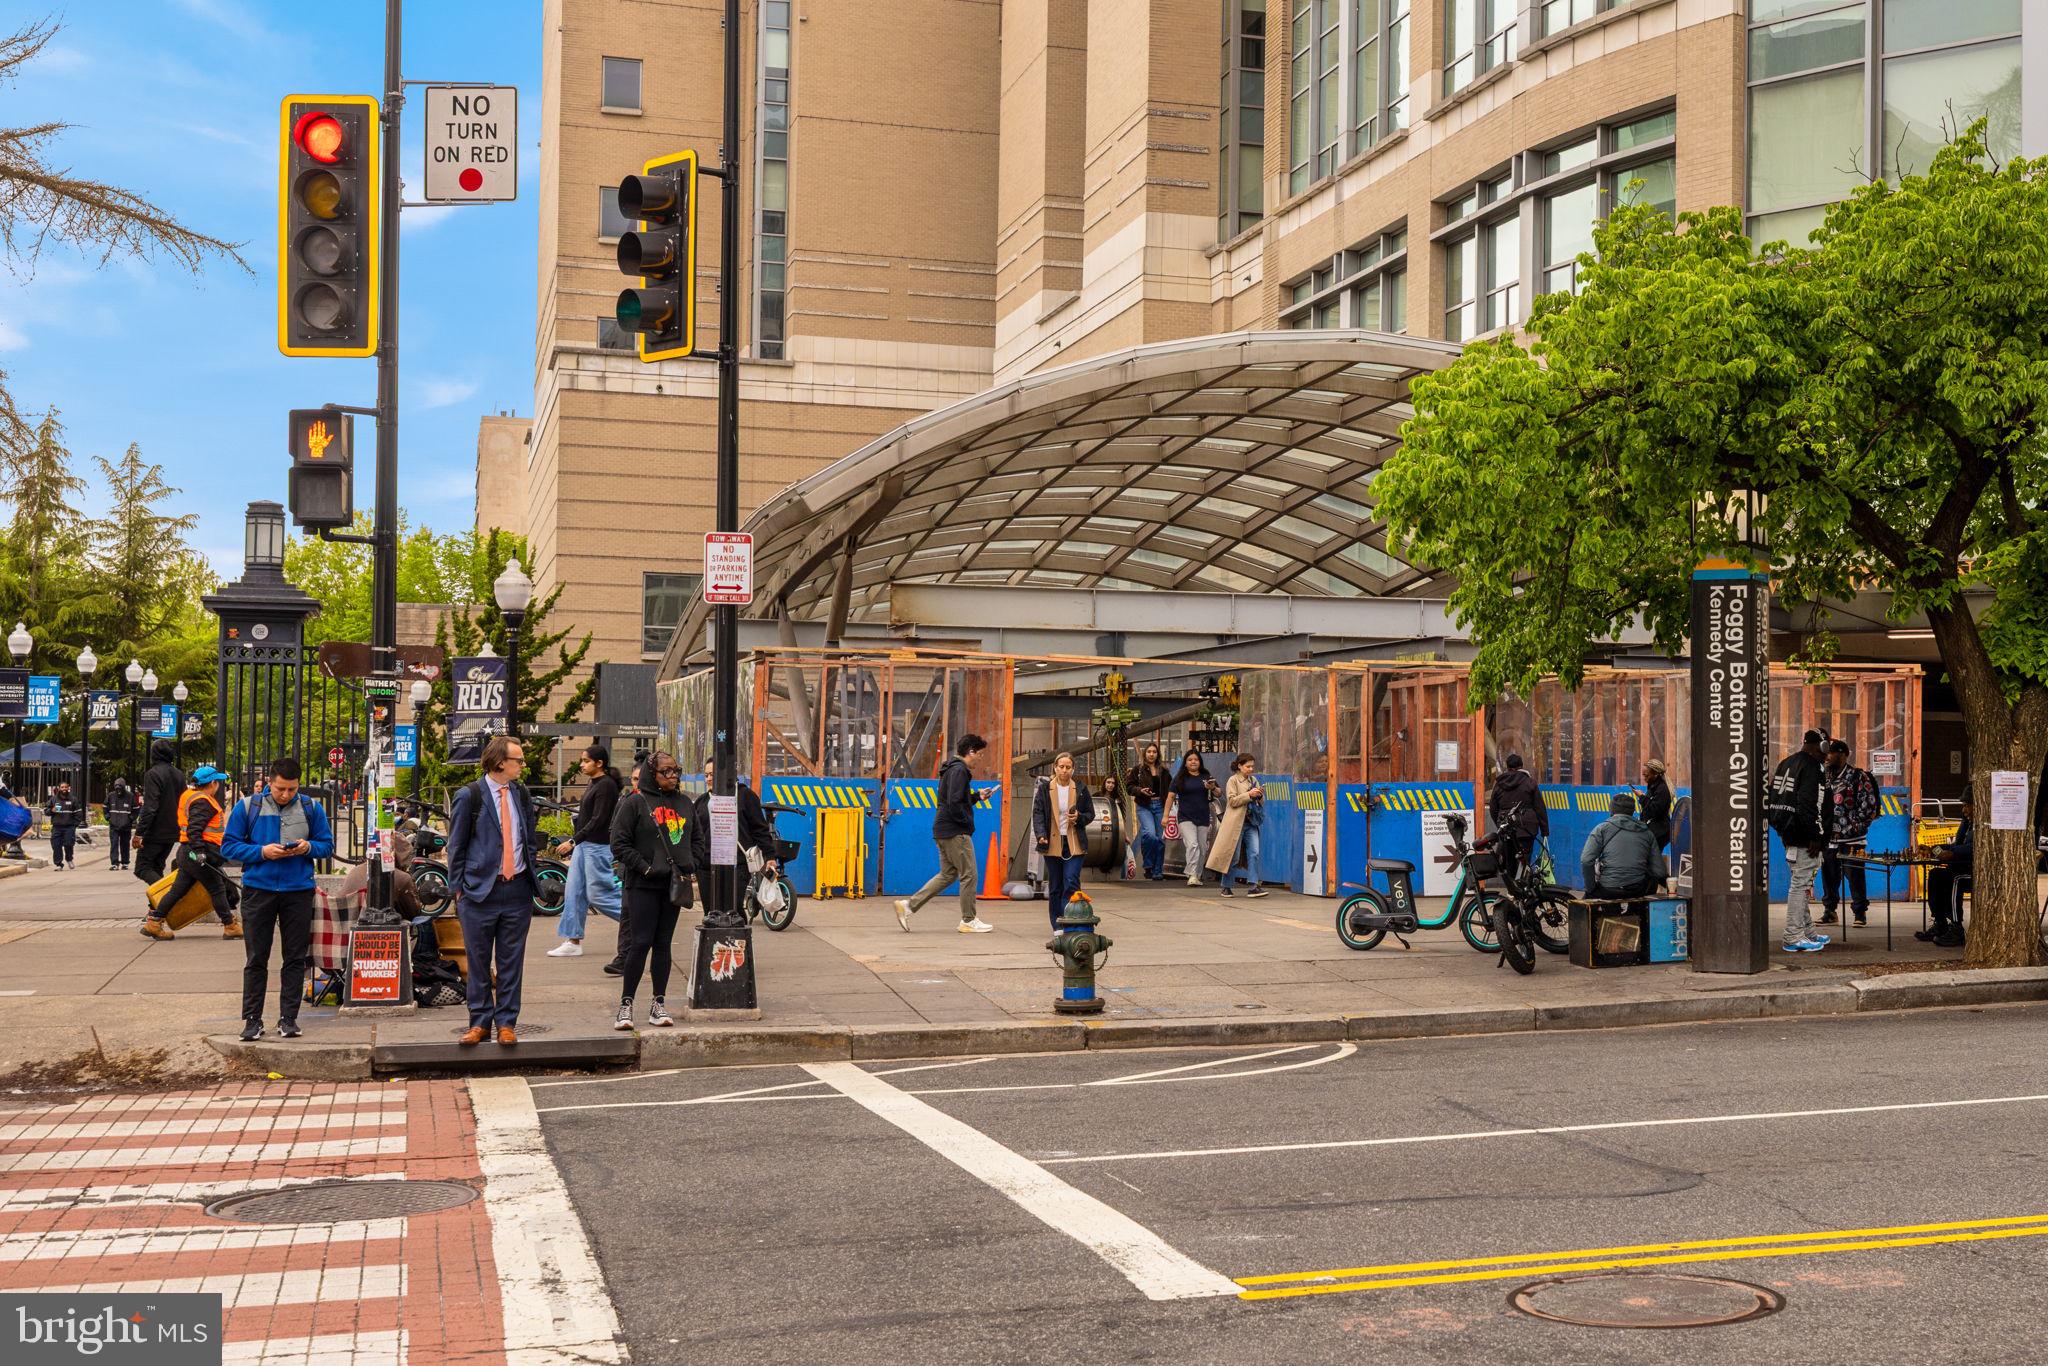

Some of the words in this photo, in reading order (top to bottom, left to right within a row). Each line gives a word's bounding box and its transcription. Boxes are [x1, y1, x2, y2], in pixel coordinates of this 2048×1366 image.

[452, 95, 490, 116] NO
[445, 122, 497, 140] TURN
[434, 146, 460, 163] ON
[471, 146, 508, 163] RED
[722, 545, 735, 553] NO
[711, 555, 746, 563] STANDING
[716, 564, 748, 573] PARKING
[714, 573, 744, 582] ANYTIME
[1706, 585, 1725, 664] Kennedy
[1724, 585, 1748, 655] Foggy
[1761, 589, 1769, 657] Foggy
[457, 683, 504, 711] REVS
[1709, 668, 1725, 729] Center
[37, 706, 49, 717] GW
[92, 703, 118, 717] REVS
[184, 721, 202, 734] REVS
[529, 724, 539, 734] M
[1729, 662, 1749, 810] Bottom-GWU
[1729, 817, 1748, 892] Station
[1393, 879, 1406, 909] veo
[361, 933, 400, 941] UNIVERSITY
[354, 941, 387, 950] SHOULD
[388, 942, 400, 950] BE
[354, 950, 372, 959] RUN
[374, 951, 386, 959] BY
[387, 950, 400, 959] ITS
[353, 960, 399, 970] STUDENTS
